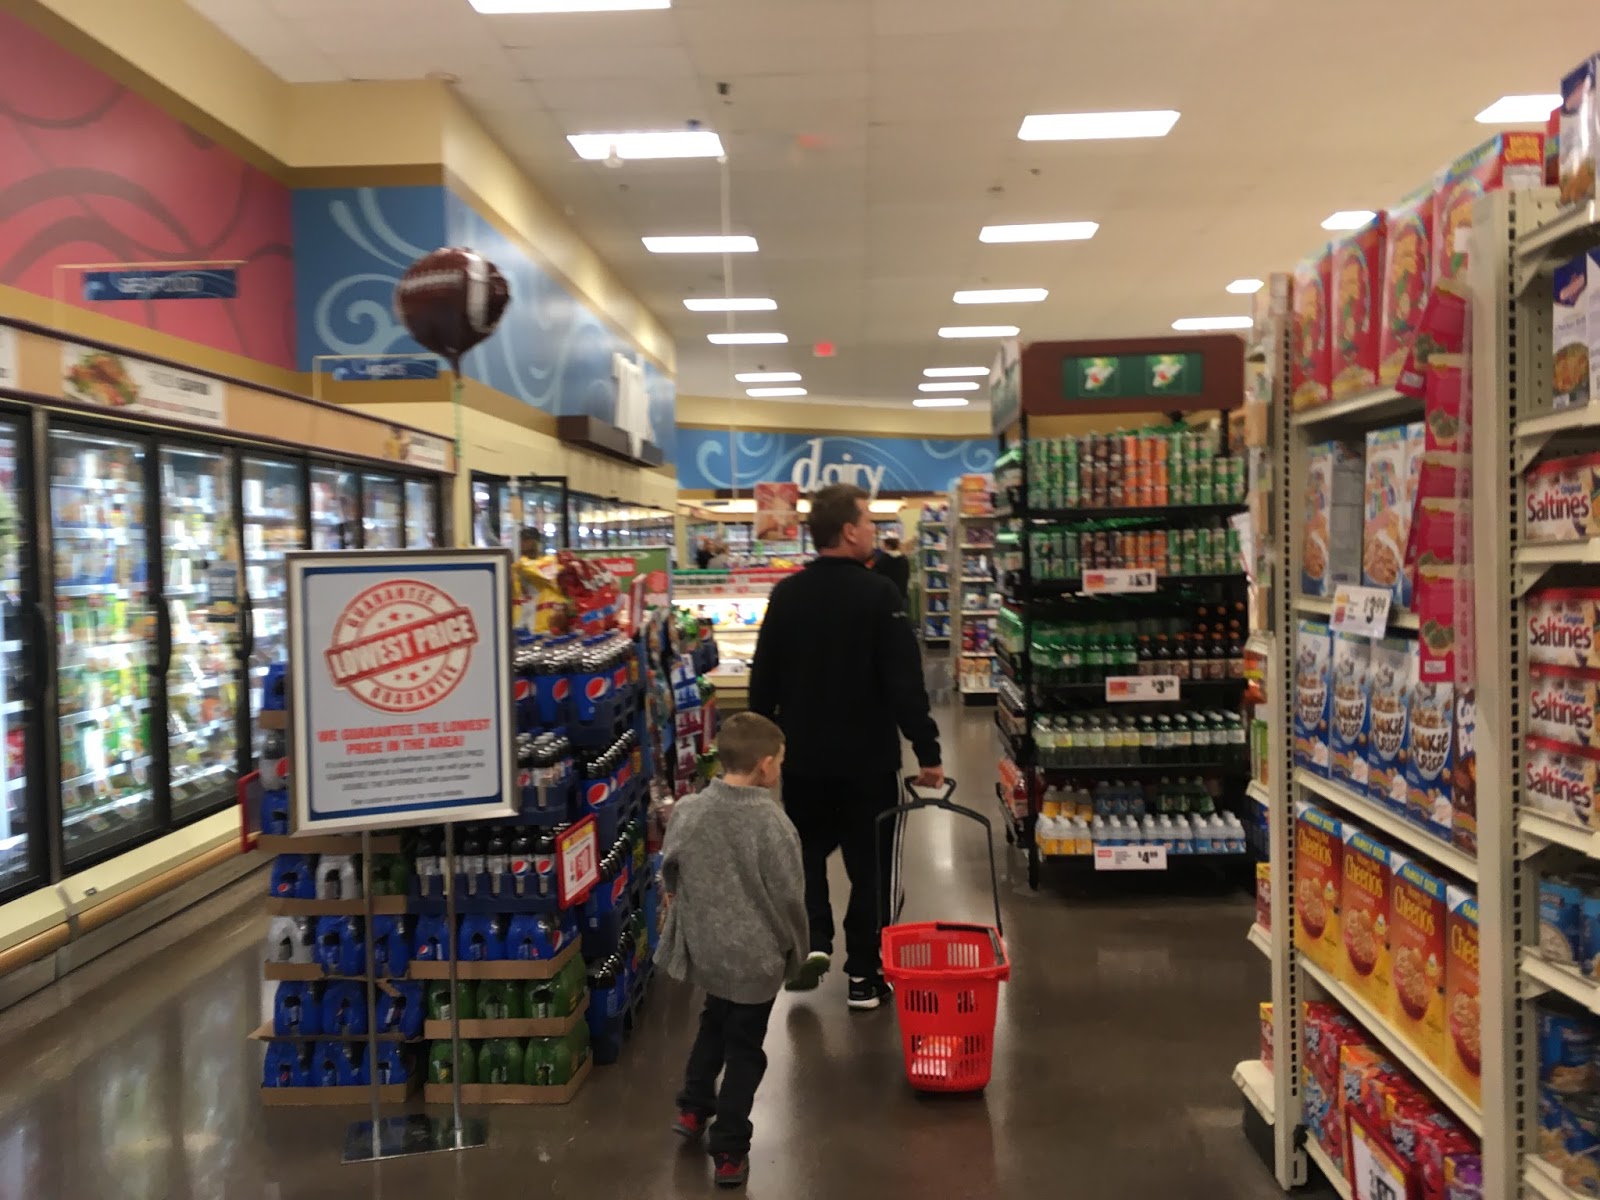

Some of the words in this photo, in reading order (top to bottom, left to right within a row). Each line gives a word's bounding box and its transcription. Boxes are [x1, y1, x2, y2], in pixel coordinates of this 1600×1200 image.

[791, 437, 887, 503] dairy
[1527, 491, 1590, 523] Saltines
[330, 631, 413, 680] LOWEST
[412, 613, 476, 654] PRICE
[1529, 615, 1592, 649] Saltines
[317, 729, 338, 743] WE
[341, 724, 414, 741] GUARANTEE
[417, 722, 439, 734] THE
[443, 719, 491, 733] LOWEST
[1531, 690, 1593, 729] Saltines
[346, 741, 383, 755] PRICE
[387, 740, 400, 751] IN
[403, 738, 425, 750] THE
[1527, 761, 1592, 809] Saltines
[1298, 827, 1333, 868] Cheerios
[1345, 854, 1384, 899] Cheerios
[1395, 885, 1436, 937] Cheerios
[1452, 924, 1479, 970] Chee
